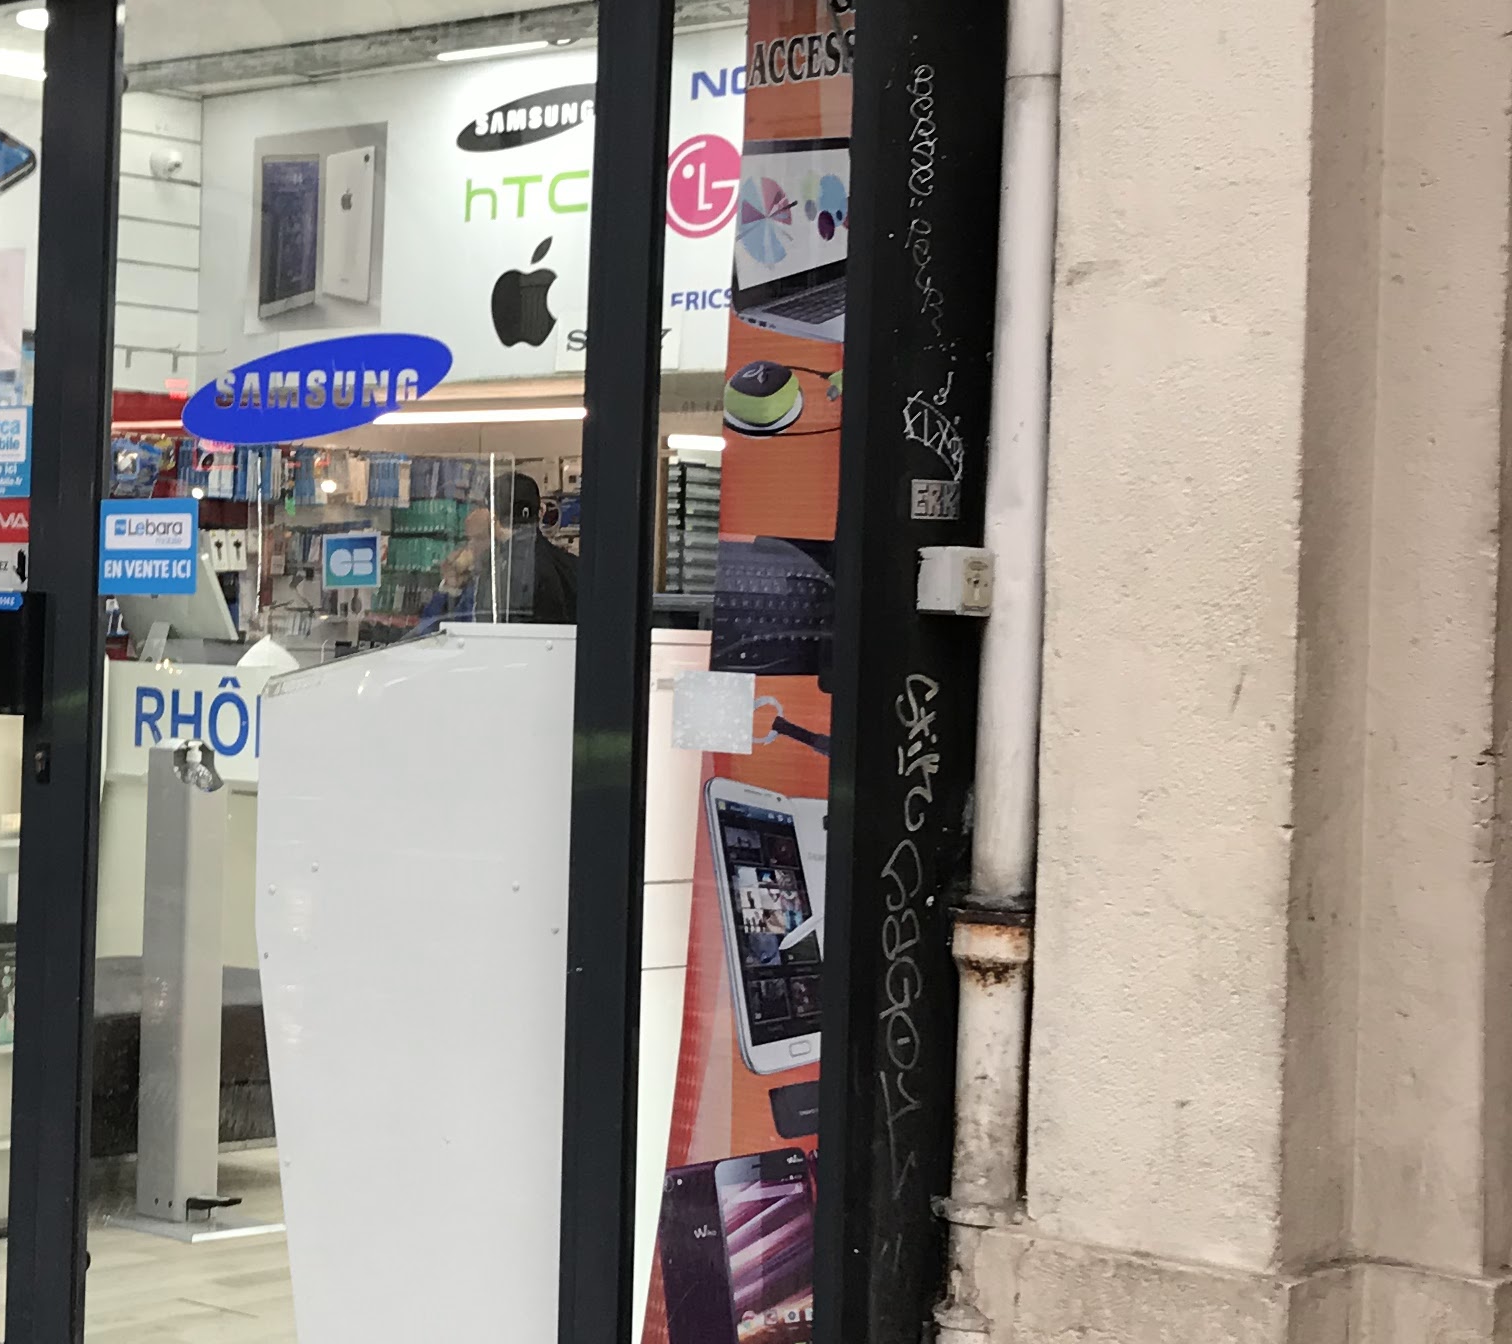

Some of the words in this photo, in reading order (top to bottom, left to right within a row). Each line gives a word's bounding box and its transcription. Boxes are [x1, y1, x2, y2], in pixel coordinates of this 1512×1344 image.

[474, 99, 595, 136] SAMSUNG
[214, 368, 419, 409] SAMSUNG
[128, 518, 183, 536] Lebara
[104, 559, 123, 579] EN
[124, 559, 170, 579] VENTE
[172, 559, 192, 579] ICI
[134, 675, 262, 759] RHÔ
